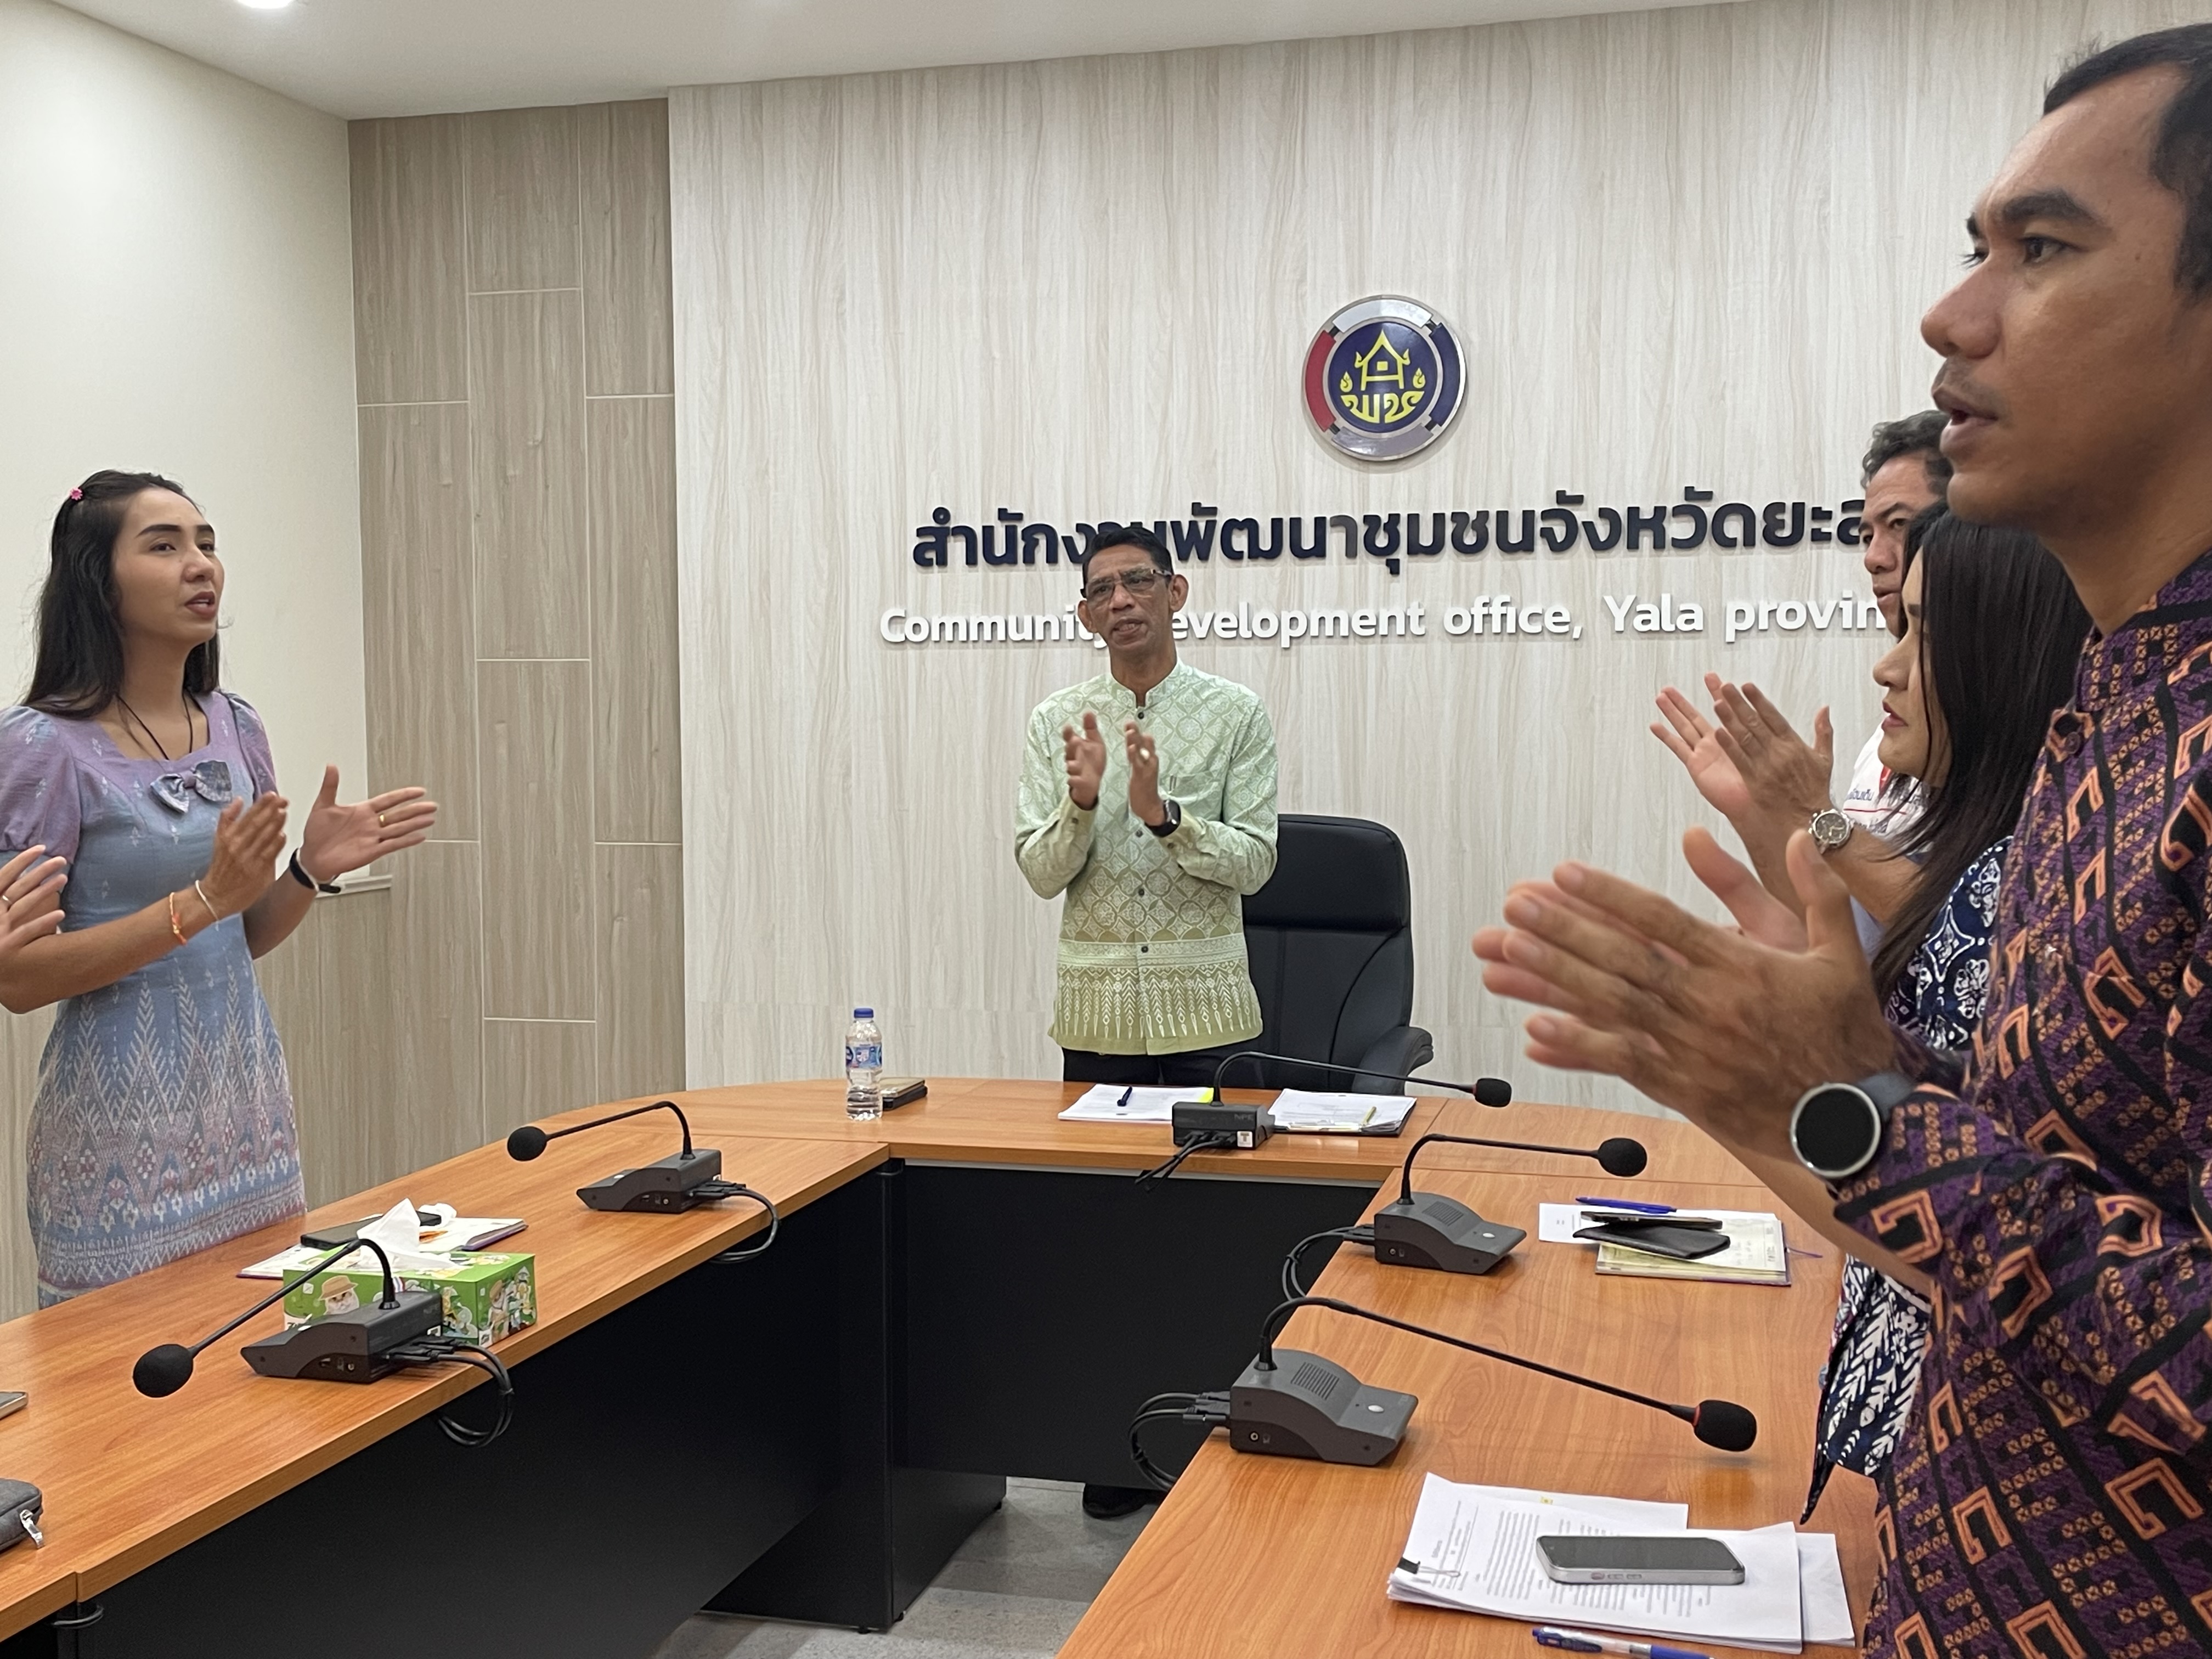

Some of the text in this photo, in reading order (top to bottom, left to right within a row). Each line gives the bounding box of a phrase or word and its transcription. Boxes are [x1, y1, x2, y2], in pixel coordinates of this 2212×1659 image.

[880, 589, 1886, 648] Communit evelopment office, Yala provin
